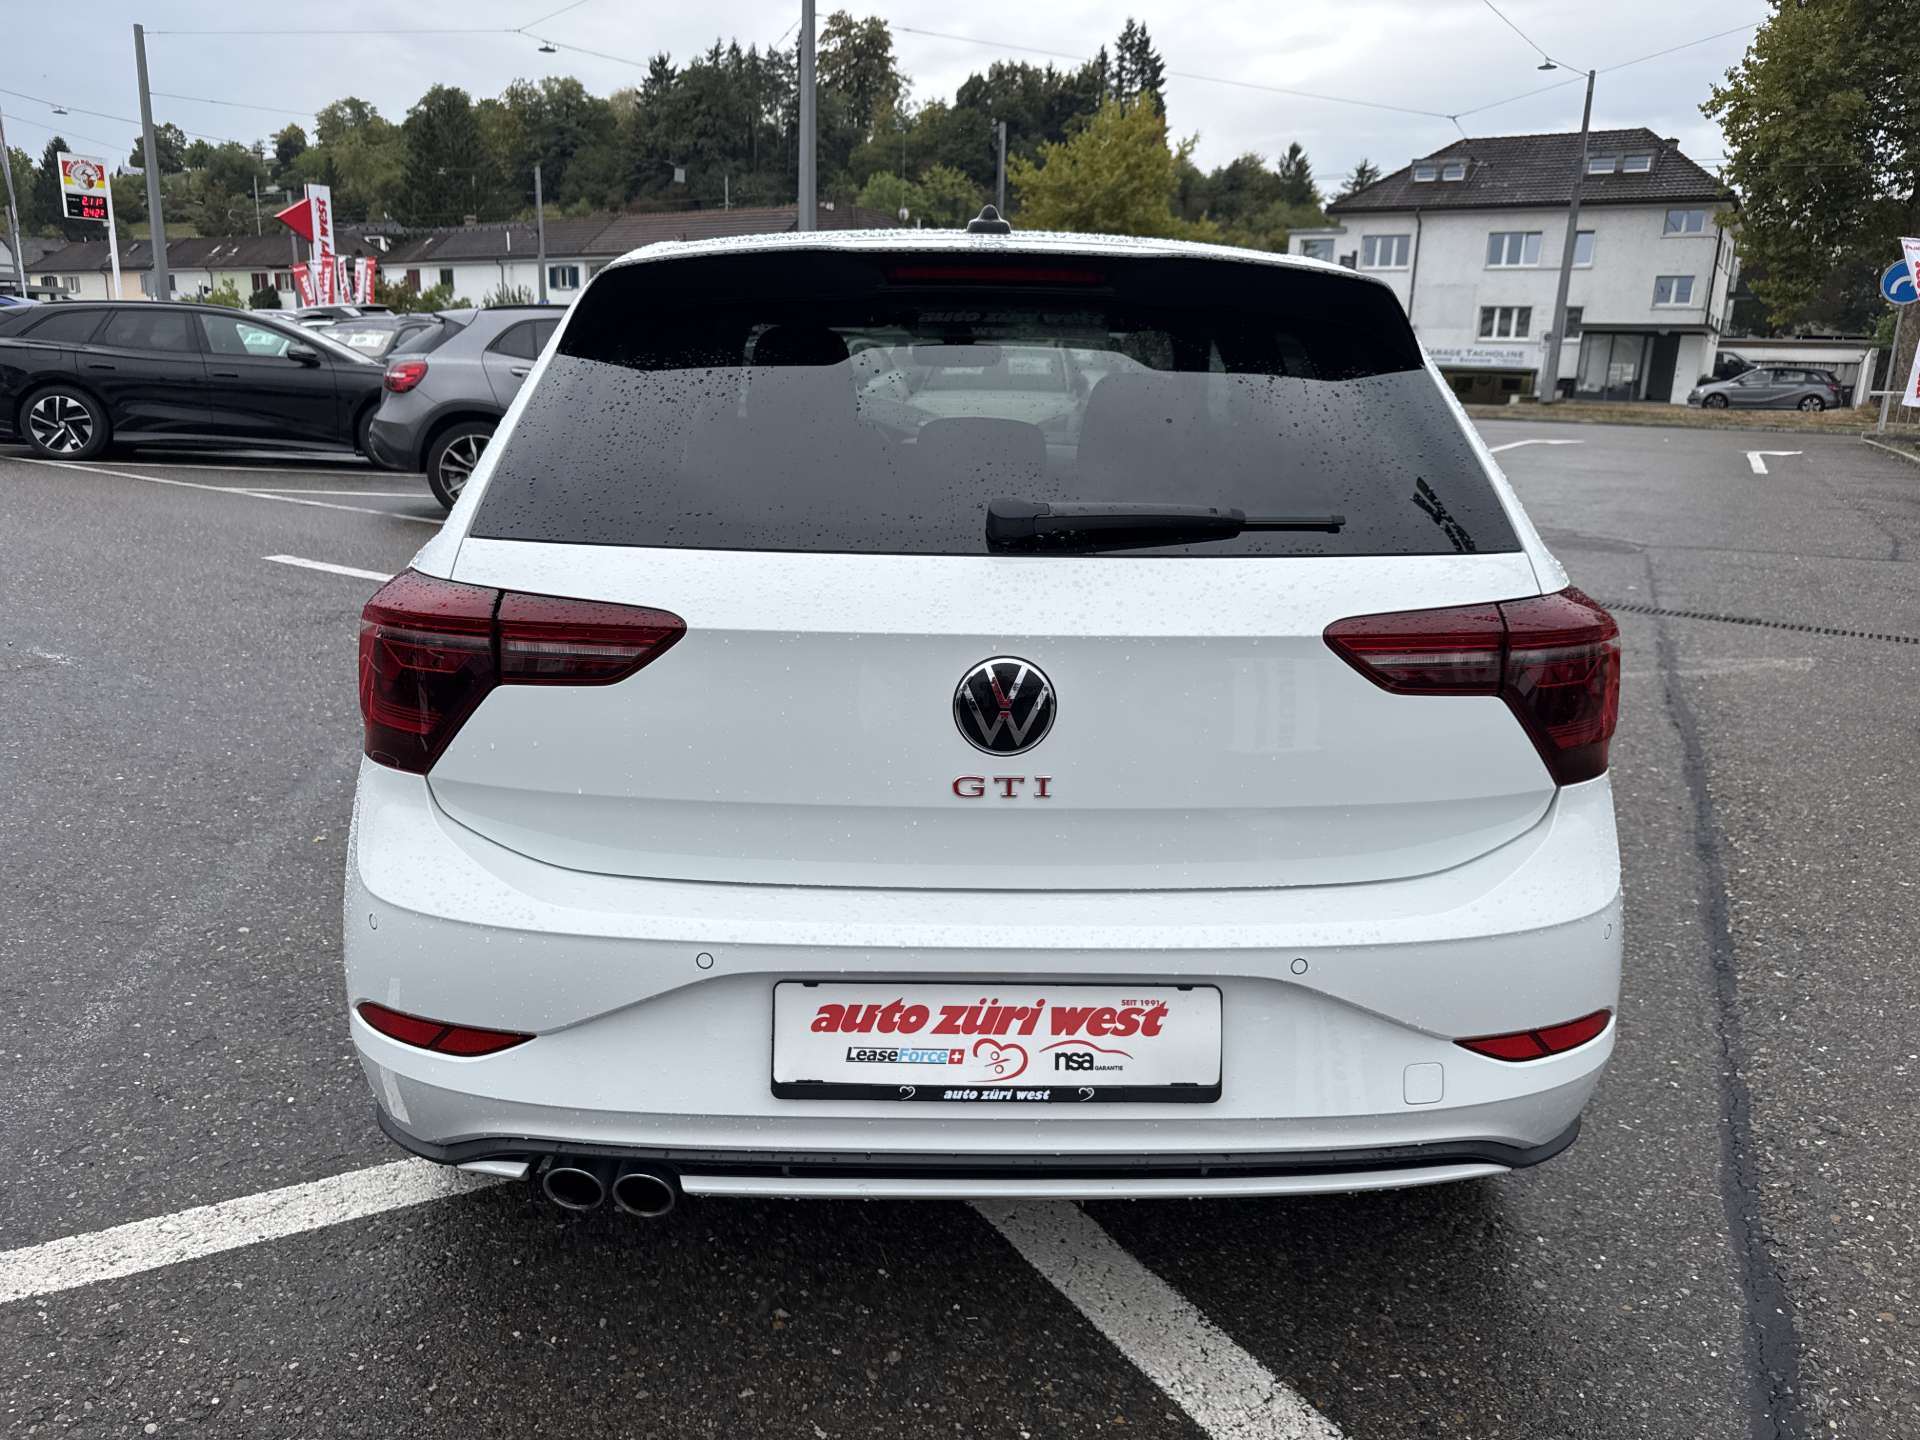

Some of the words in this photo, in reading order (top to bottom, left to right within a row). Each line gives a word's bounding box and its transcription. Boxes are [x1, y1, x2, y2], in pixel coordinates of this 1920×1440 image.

[952, 775, 1053, 799] GTI
[1121, 999, 1137, 1007] SEIT
[1140, 999, 1161, 1007] 1991
[810, 997, 930, 1034] auto
[930, 998, 1046, 1036] züri
[1050, 1000, 1169, 1037] west
[845, 1046, 948, 1063] LeaseForce
[1054, 1052, 1094, 1071] nsa
[943, 1089, 978, 1100] auto
[980, 1088, 1013, 1100] züri
[1016, 1089, 1050, 1100] west
